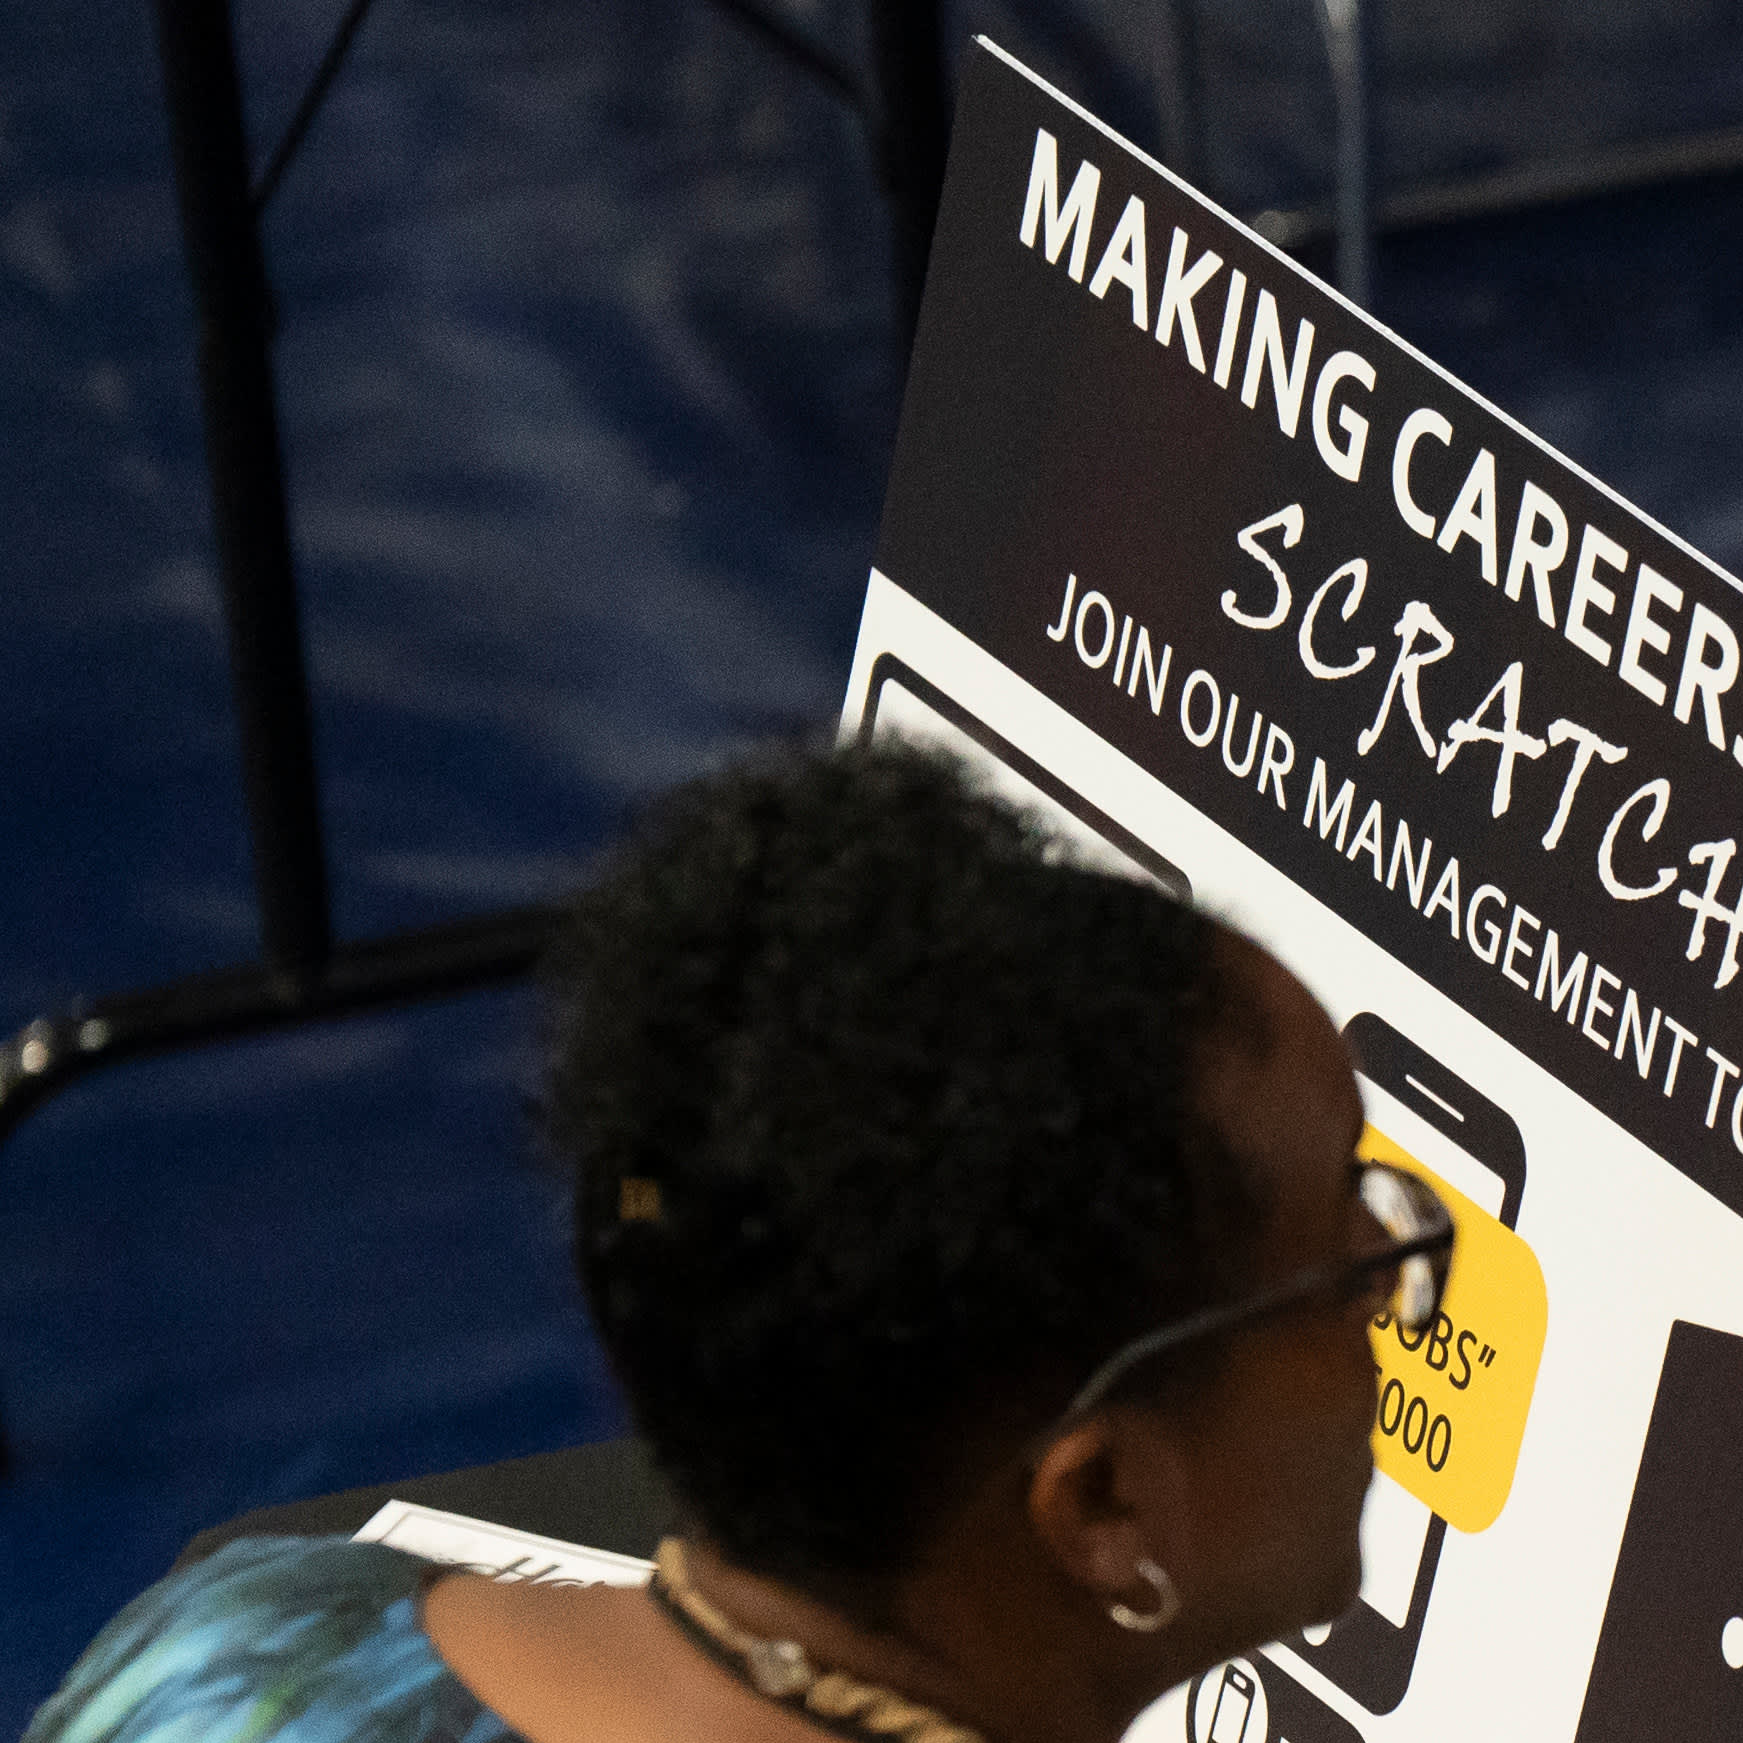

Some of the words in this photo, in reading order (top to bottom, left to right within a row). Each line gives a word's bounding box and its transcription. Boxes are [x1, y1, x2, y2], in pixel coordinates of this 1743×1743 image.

[1019, 128, 1377, 481] MAKING
[1047, 573, 1172, 715] JOIN
[1180, 667, 1298, 811] OUR
[1302, 756, 1698, 1097] MANAGEMENT
